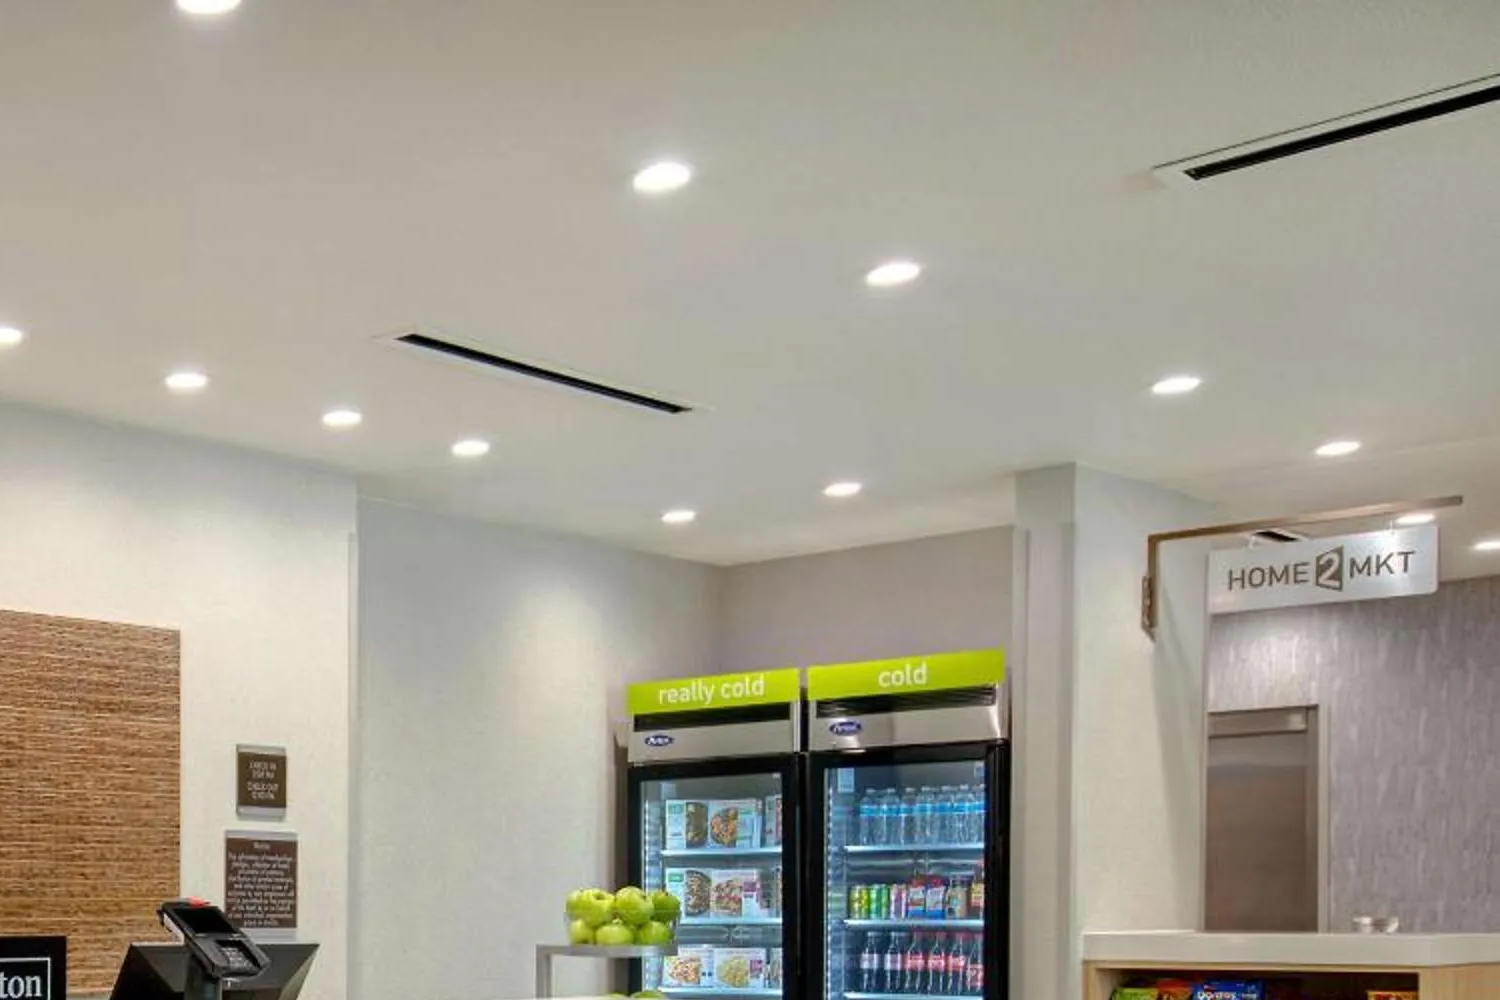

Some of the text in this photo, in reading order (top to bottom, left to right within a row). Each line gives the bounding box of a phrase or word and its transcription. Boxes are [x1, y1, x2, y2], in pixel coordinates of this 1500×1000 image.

[1227, 562, 1310, 591] HOME
[1349, 550, 1416, 579] MKT
[658, 674, 765, 706] really cold
[877, 662, 929, 687] cold
